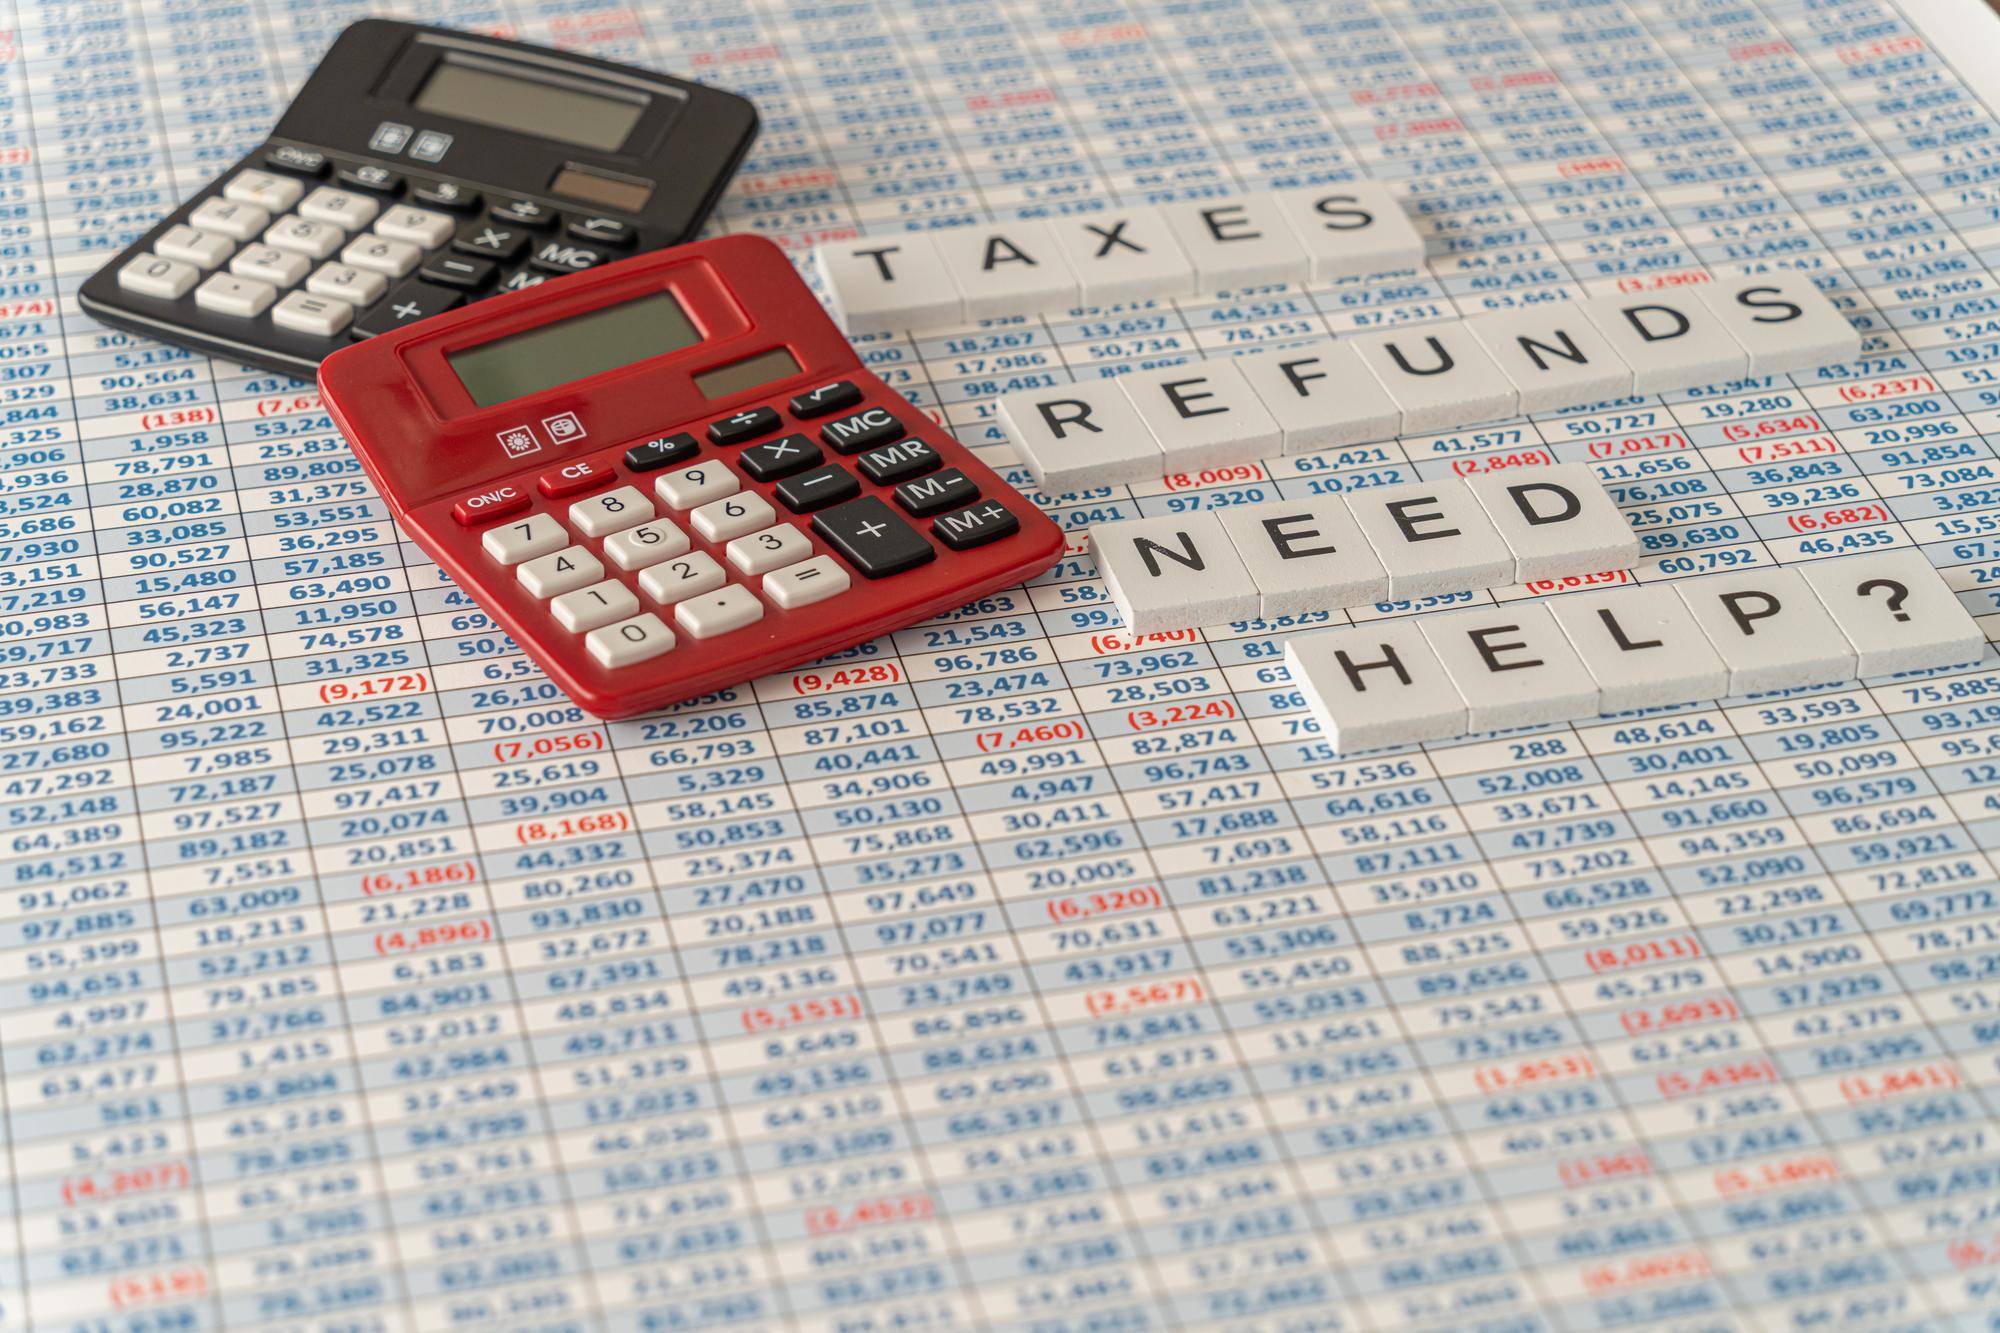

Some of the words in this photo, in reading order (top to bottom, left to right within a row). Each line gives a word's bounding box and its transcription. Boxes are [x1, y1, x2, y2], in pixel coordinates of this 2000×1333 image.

[854, 196, 1372, 281] TAXES
[148, 260, 171, 276] 0
[539, 243, 598, 268] MC
[1210, 301, 1300, 321] 44,521
[1080, 317, 1166, 338] 13,657
[947, 332, 1034, 353] 18,267
[1089, 338, 1179, 356] 50,734
[1035, 287, 1802, 439] REFUNDS
[1818, 358, 1908, 378] 43,724
[101, 369, 195, 389] 90,564
[964, 373, 1055, 396] 98,481
[1839, 378, 1934, 403] (6,237)
[104, 389, 198, 411] 38,631
[1701, 396, 1792, 418] 19,280
[1849, 400, 1942, 422] 63,200
[141, 408, 214, 431] (138)
[835, 410, 892, 437] MC
[1566, 413, 1655, 435] 50,727
[1723, 416, 1819, 441] (5,634)
[130, 431, 210, 453] 1,958
[648, 438, 675, 452] %
[1433, 430, 1521, 452] 41,577
[1589, 433, 1686, 458] (7,017)
[1865, 422, 1959, 444] 20,996
[869, 440, 928, 468] MR
[1296, 448, 1386, 472] 61,421
[1452, 450, 1550, 477] (2,848)
[1738, 438, 1837, 464] (7,511)
[1881, 443, 1976, 466] 91,854
[115, 454, 212, 476] 78,791
[561, 463, 593, 478] CE
[685, 470, 705, 485] 9
[1597, 457, 1691, 480] 11,656
[1747, 459, 1844, 485] 36,843
[1898, 466, 1994, 489] 73,084
[119, 475, 218, 499] 28,870
[910, 477, 963, 500] M-
[1163, 464, 1263, 492] (8,009)
[1307, 470, 1404, 495] 10,212
[271, 482, 367, 504] 31,375
[467, 487, 516, 509] ON/C
[1167, 489, 1265, 512] 97,320
[1611, 479, 1708, 503] 76,108
[1763, 483, 1859, 508] 39,236
[122, 498, 221, 522] 60,082
[274, 505, 372, 528] 53,551
[601, 497, 625, 512] 8
[725, 501, 745, 517] 6
[1629, 502, 1723, 526] 25,075
[945, 505, 1004, 532] M+
[1132, 482, 1582, 577] NEED
[1788, 504, 1887, 533] (6,682)
[127, 521, 226, 545] 33,085
[514, 523, 532, 542] 7
[636, 527, 660, 544] 5
[758, 534, 782, 550] 3
[1642, 525, 1739, 549] 89,630
[1799, 530, 1894, 554] 46,435
[130, 545, 229, 569] 90,527
[555, 556, 575, 573] 4
[1659, 549, 1753, 573] 60,792
[136, 569, 237, 594] 15,480
[672, 562, 698, 579] 2
[139, 594, 240, 619] 56,147
[587, 590, 608, 605] 1
[295, 600, 398, 625] 11,950
[301, 625, 403, 649] 74,578
[621, 624, 646, 642] 0
[928, 622, 1025, 647] 21,543
[1334, 578, 1910, 692] HELP?
[169, 643, 249, 667] 2,737
[306, 650, 409, 675] 31,325
[934, 647, 1037, 671] 96,786
[1095, 651, 1196, 677] 73,962
[319, 672, 427, 704] (9,172)
[792, 663, 900, 695] (9,428)
[946, 672, 1049, 699] 23,474
[1107, 677, 1209, 703] 28,503
[159, 695, 258, 722] 24,001
[795, 692, 899, 719] 85,874
[963, 698, 1056, 723] 78,532
[1128, 700, 1235, 730] (3,224)
[1763, 699, 1861, 724] 33,593
[481, 710, 583, 732] 70,008
[644, 714, 746, 740] 22,206
[806, 720, 906, 745] 87,101
[1614, 720, 1714, 744] 48,614
[326, 728, 425, 753] 29,311
[493, 731, 603, 763] (7,056)
[976, 721, 1084, 752] (7,460)
[1133, 729, 1236, 754] 82,874
[1778, 724, 1879, 751] 19,805
[2, 742, 110, 769] 27,680
[190, 749, 271, 772] 7,985
[651, 741, 755, 764] 66,793
[982, 750, 1082, 774] 49,991
[1514, 740, 1566, 760] 288
[329, 755, 436, 782] 25,078
[1312, 764, 1416, 788] 57,536
[1797, 752, 1897, 778] 50,099
[5, 771, 112, 795] 47,292
[170, 775, 276, 802] 72,187
[677, 767, 765, 791] 5,329
[830, 773, 929, 798] 34,906
[1011, 775, 1093, 800] 4,947
[1478, 766, 1584, 794] 52,008
[1648, 773, 1749, 798] 14,145
[502, 787, 608, 814] 39,904
[1158, 782, 1259, 806] 57,417
[9, 797, 118, 824] 52,148
[834, 798, 942, 825] 50,130
[1009, 804, 1106, 828] 30,411
[1499, 796, 1596, 820] 33,671
[1663, 800, 1768, 827] 91,660
[1833, 807, 1936, 832] 86,694
[343, 809, 449, 837] 20,074
[516, 811, 629, 845] (8,168)
[676, 821, 784, 847] 50,853
[1173, 810, 1279, 837] 17,688
[1341, 818, 1446, 842] 58,116
[1512, 821, 1616, 848] 47,739
[12, 825, 122, 852] 64,389
[179, 831, 287, 858] 89,182
[1014, 831, 1123, 859] 62,596
[1212, 839, 1290, 860] 7,693
[1681, 829, 1784, 853] 94,359
[1850, 834, 1956, 861] 59,921
[16, 853, 124, 881] 84,512
[516, 842, 623, 869] 44,332
[1355, 844, 1462, 873] 87,111
[362, 863, 475, 895] (6,186)
[1698, 857, 1805, 884] 52,090
[19, 882, 128, 908] 91,062
[696, 877, 805, 905] 27,470
[1544, 880, 1652, 908] 66,528
[1047, 887, 1161, 923] (6,320)
[1405, 903, 1495, 929] 8,724
[375, 921, 490, 955] (4,896)
